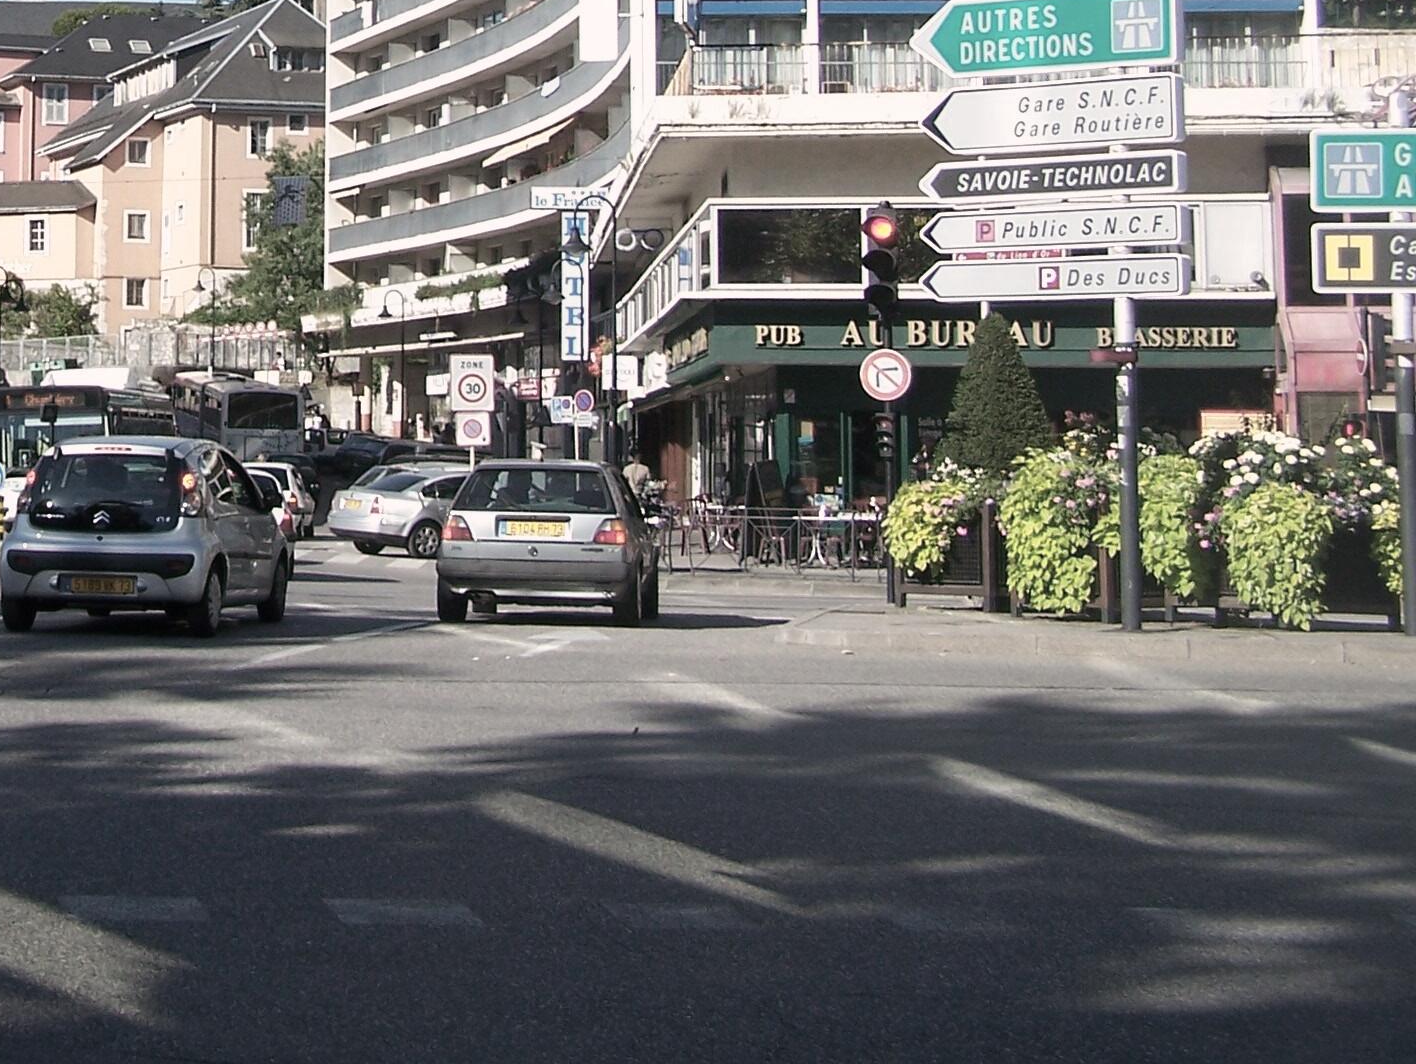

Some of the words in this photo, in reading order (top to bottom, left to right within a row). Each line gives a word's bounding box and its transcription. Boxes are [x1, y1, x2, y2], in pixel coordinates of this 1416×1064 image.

[960, 4, 1057, 35] AUTRES
[959, 32, 1093, 65] DIRECTIONS
[1018, 95, 1065, 114] Gare
[1078, 86, 1165, 108] S.N.C.F.
[1014, 120, 1061, 138] Gare
[1074, 113, 1165, 136] Routière
[957, 163, 1167, 193] SAVOIE-TECHNOLAC
[1002, 219, 1068, 239] Public
[1082, 215, 1170, 235] S.N.C.F.
[565, 217, 586, 356] HTEL
[1067, 269, 1105, 286] Des
[1118, 267, 1171, 286] Ducs
[754, 325, 803, 346] PUB
[907, 320, 1052, 347] BURAU
[1096, 327, 1238, 348] BASSERIE
[460, 361, 484, 369] ZONE
[465, 383, 481, 395] 30
